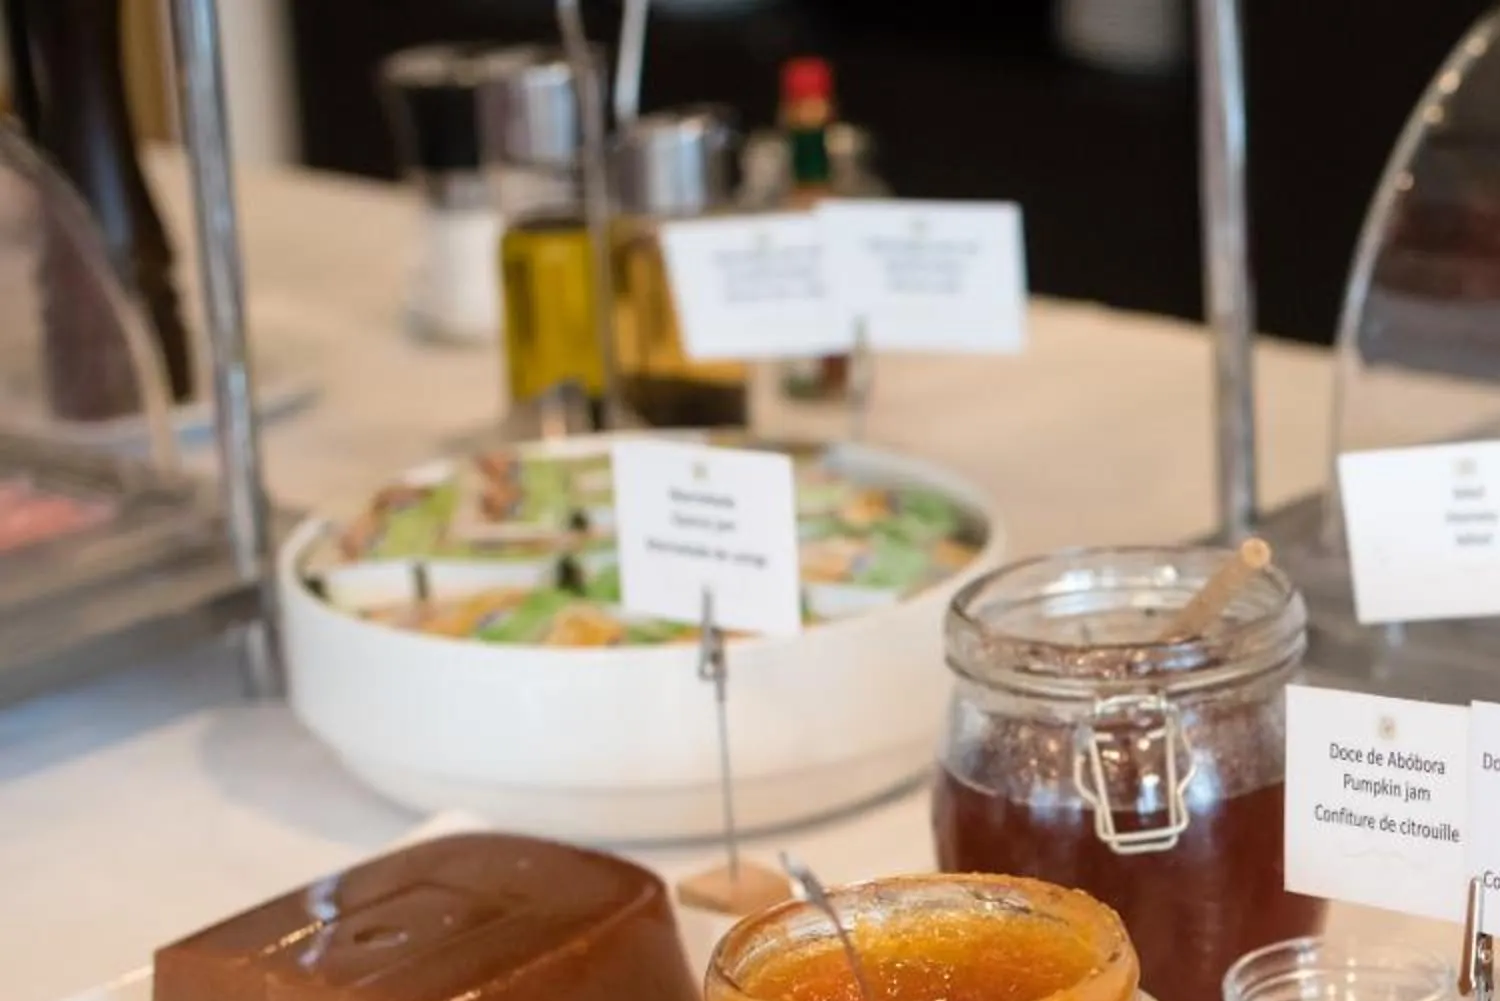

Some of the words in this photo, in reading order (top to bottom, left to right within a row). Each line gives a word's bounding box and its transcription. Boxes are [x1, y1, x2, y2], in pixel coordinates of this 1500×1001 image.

[1329, 743, 1363, 763] Doce
[1367, 749, 1384, 767] de
[1387, 751, 1445, 775] Abóbora
[1343, 773, 1402, 798] Pumpkin
[1404, 781, 1431, 803] jam
[1314, 803, 1376, 830] Confiture
[1379, 815, 1397, 833] de
[1399, 818, 1461, 843] citrouille
